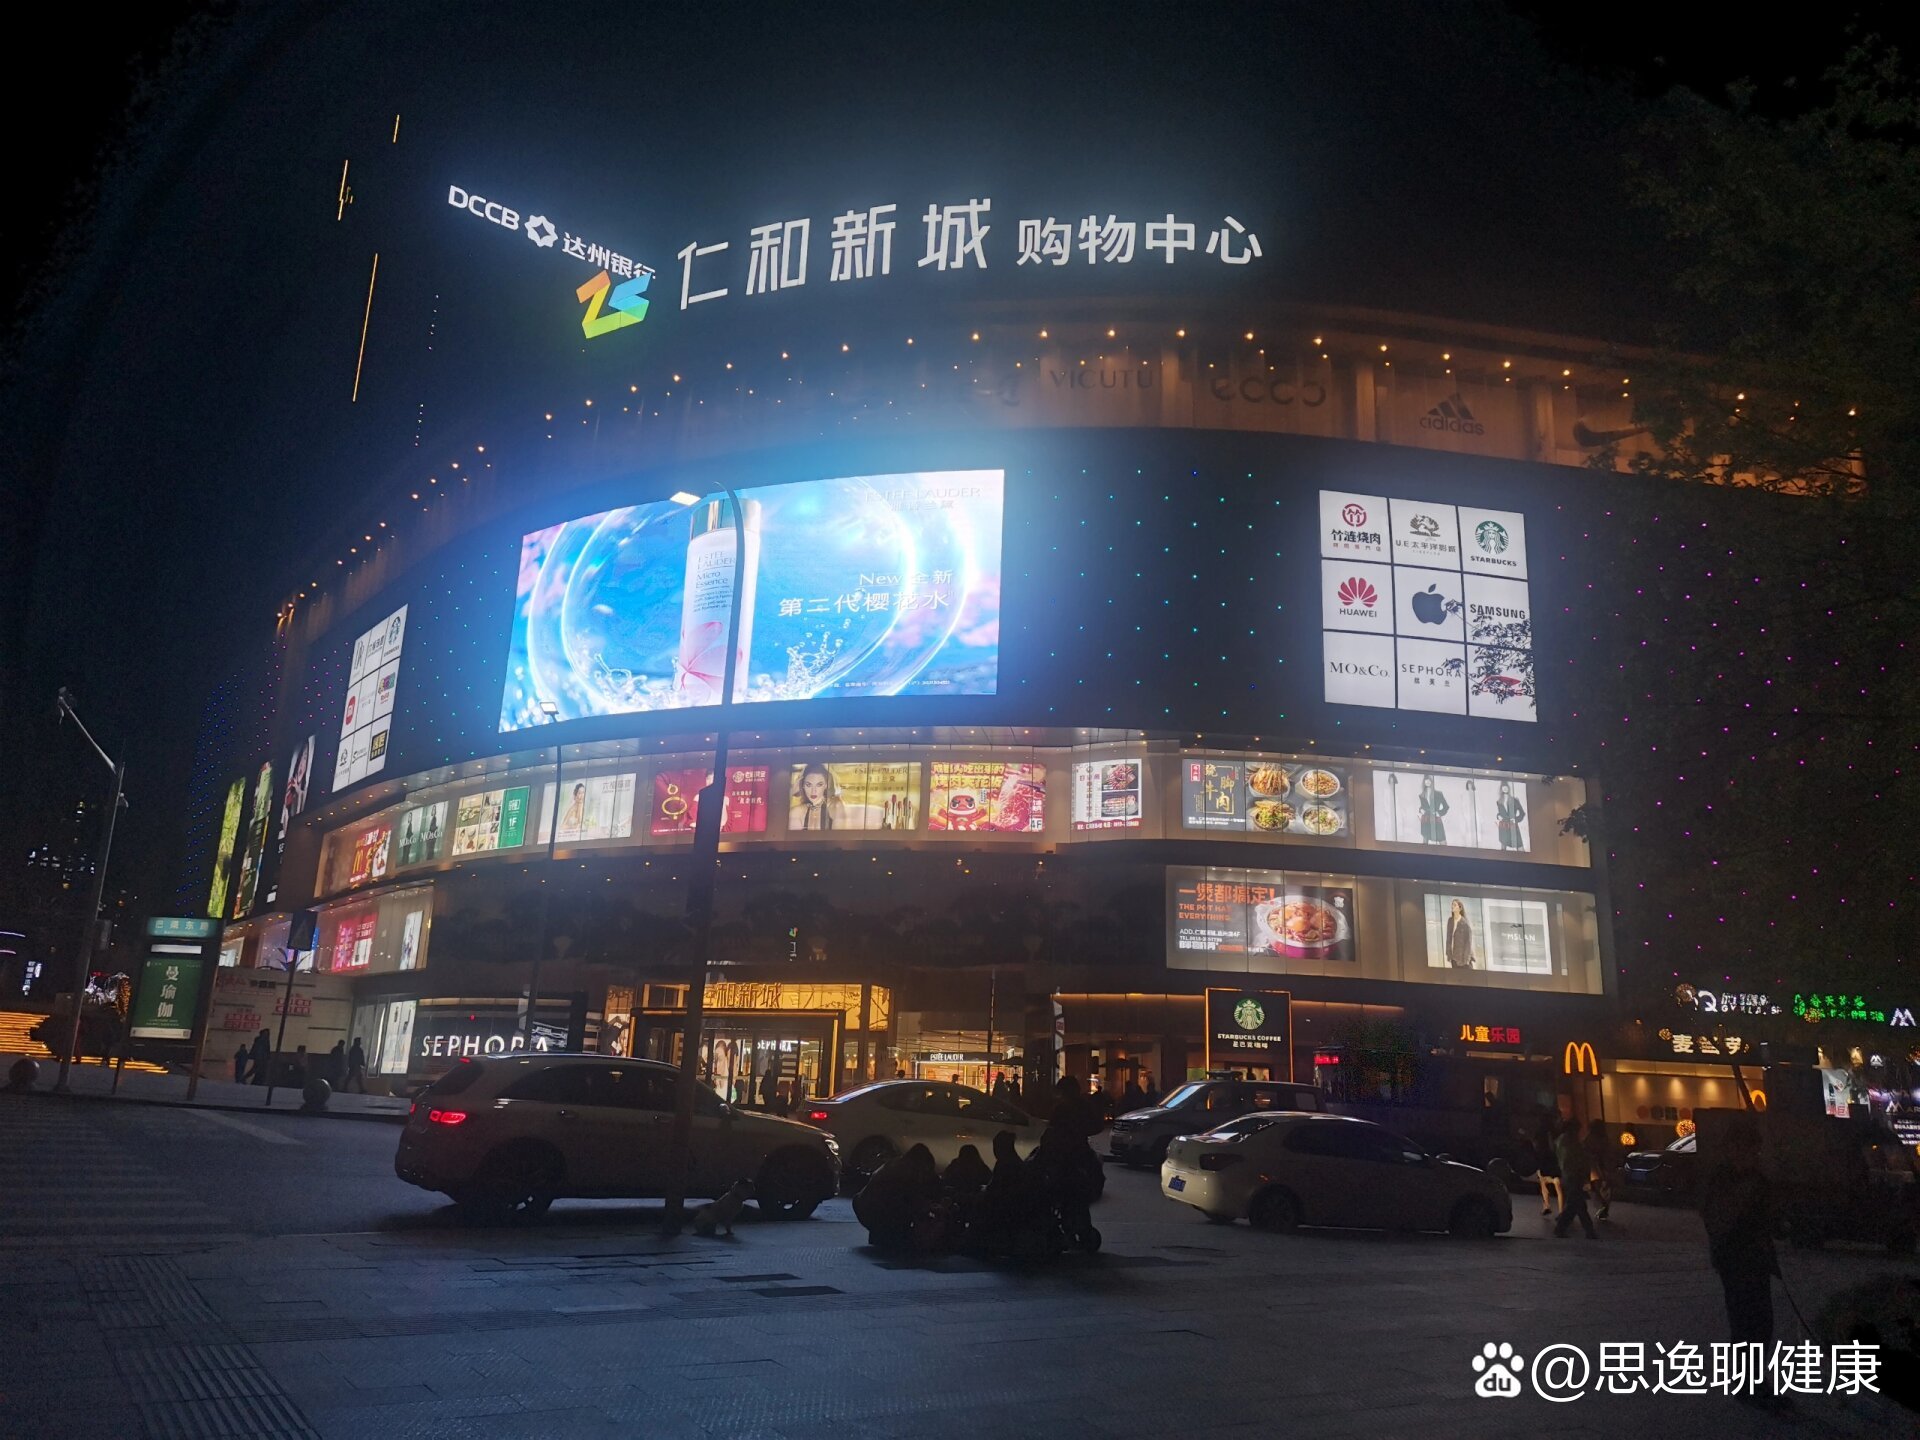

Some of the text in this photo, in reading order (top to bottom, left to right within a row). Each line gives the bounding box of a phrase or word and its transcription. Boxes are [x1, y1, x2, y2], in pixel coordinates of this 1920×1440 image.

[448, 185, 520, 230] DCCB
[1016, 213, 1263, 267] 购物中心
[677, 198, 992, 310] 仁和新城
[1049, 368, 1154, 390] VICUTU
[1419, 413, 1485, 437] adidas
[1470, 555, 1517, 567] STARBUCKS
[860, 569, 953, 586] New 全新
[1339, 607, 1378, 618] HUAWEI
[1470, 604, 1527, 620] SAMSUNG
[1401, 663, 1462, 679] SEPHORA
[1180, 903, 1195, 911] THE
[1196, 904, 1213, 912] POT
[1217, 1033, 1256, 1041] STARBUCKS
[1460, 1024, 1521, 1044] 儿童乐园
[421, 1035, 549, 1057] SEPHORA
